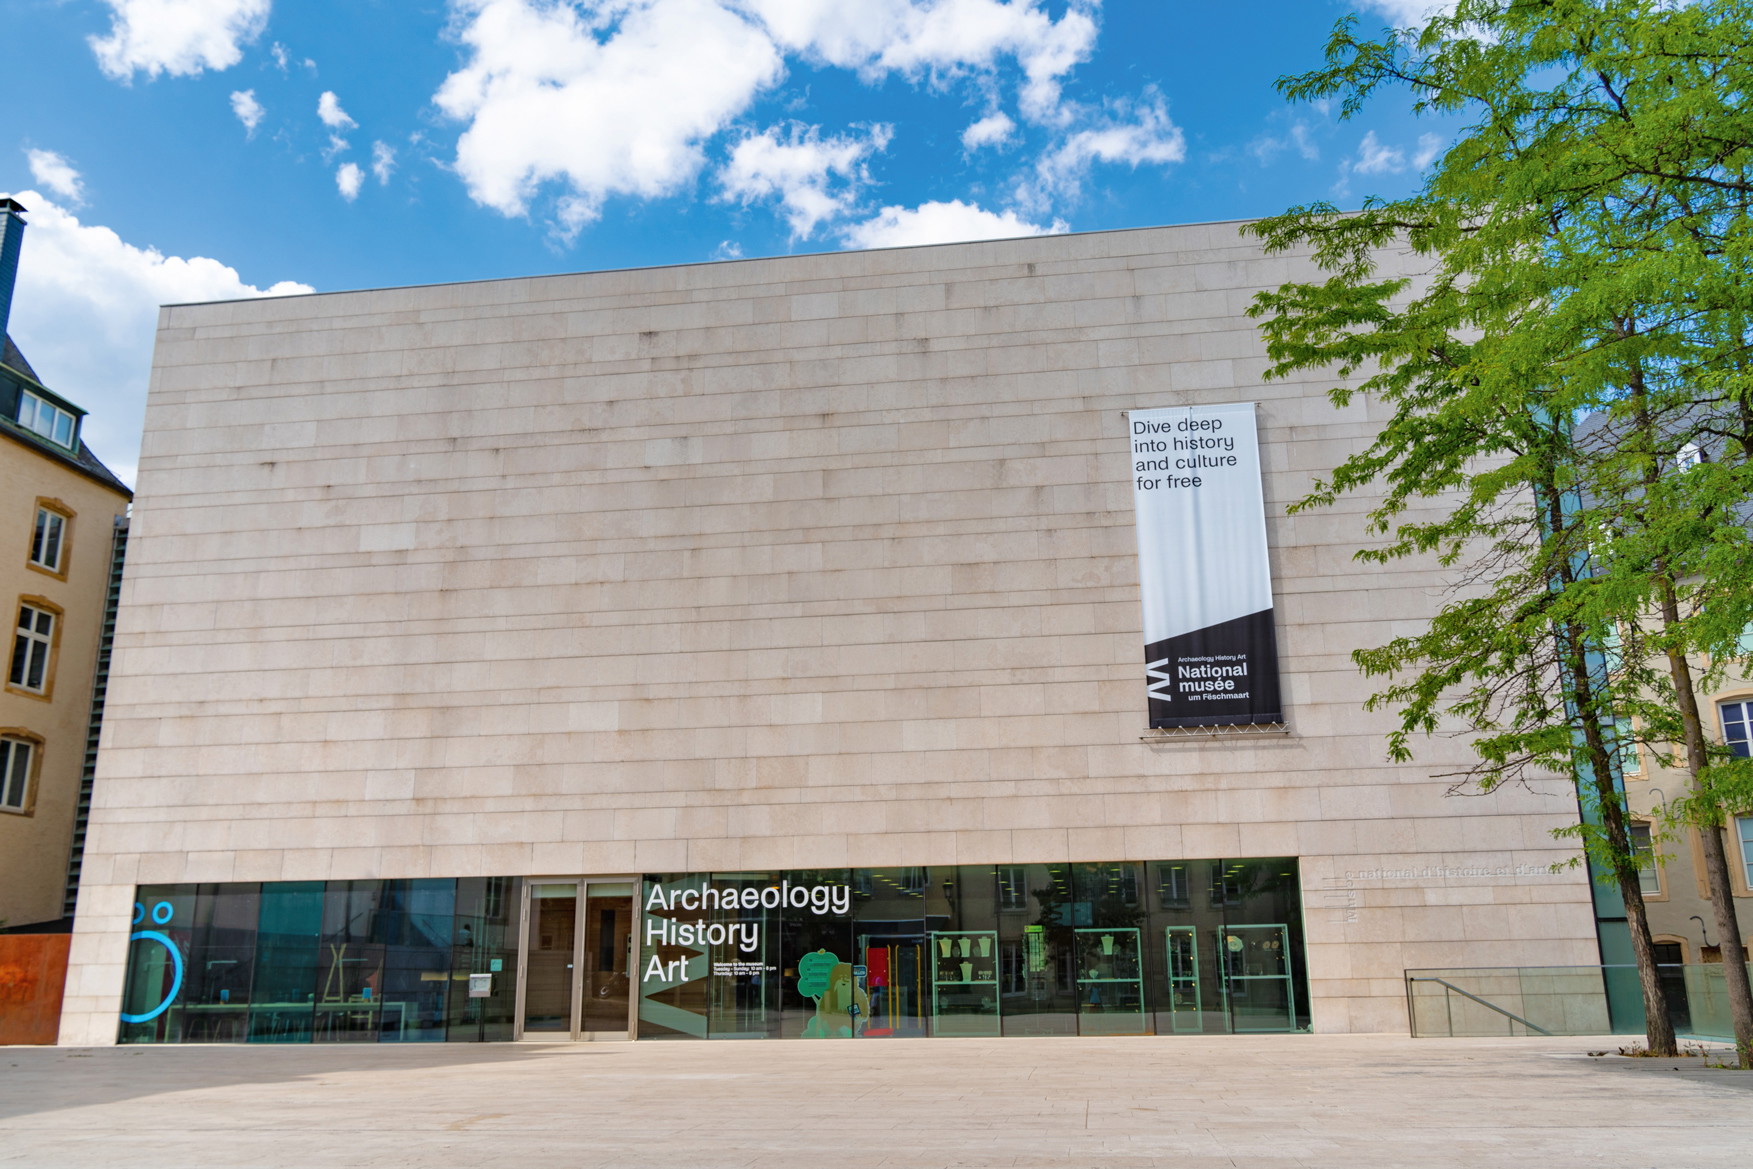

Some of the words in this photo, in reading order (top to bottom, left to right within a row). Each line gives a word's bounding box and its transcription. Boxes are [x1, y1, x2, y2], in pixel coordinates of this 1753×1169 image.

[1133, 420, 1171, 435] Dive
[1177, 418, 1222, 433] deep
[1134, 439, 1167, 453] into
[1173, 436, 1234, 451] history
[1135, 456, 1169, 472] and
[1175, 454, 1237, 469] culture
[1137, 476, 1162, 491] for
[1167, 474, 1202, 489] free
[1178, 655, 1214, 663] Archaeology
[1215, 654, 1236, 662] History
[1178, 662, 1248, 679] National
[1179, 677, 1235, 692] musée
[1188, 694, 1201, 702] um
[1202, 691, 1250, 701] Fëschmaart
[645, 880, 850, 915] Archaeology
[646, 917, 758, 953] History
[643, 954, 689, 982] Art
